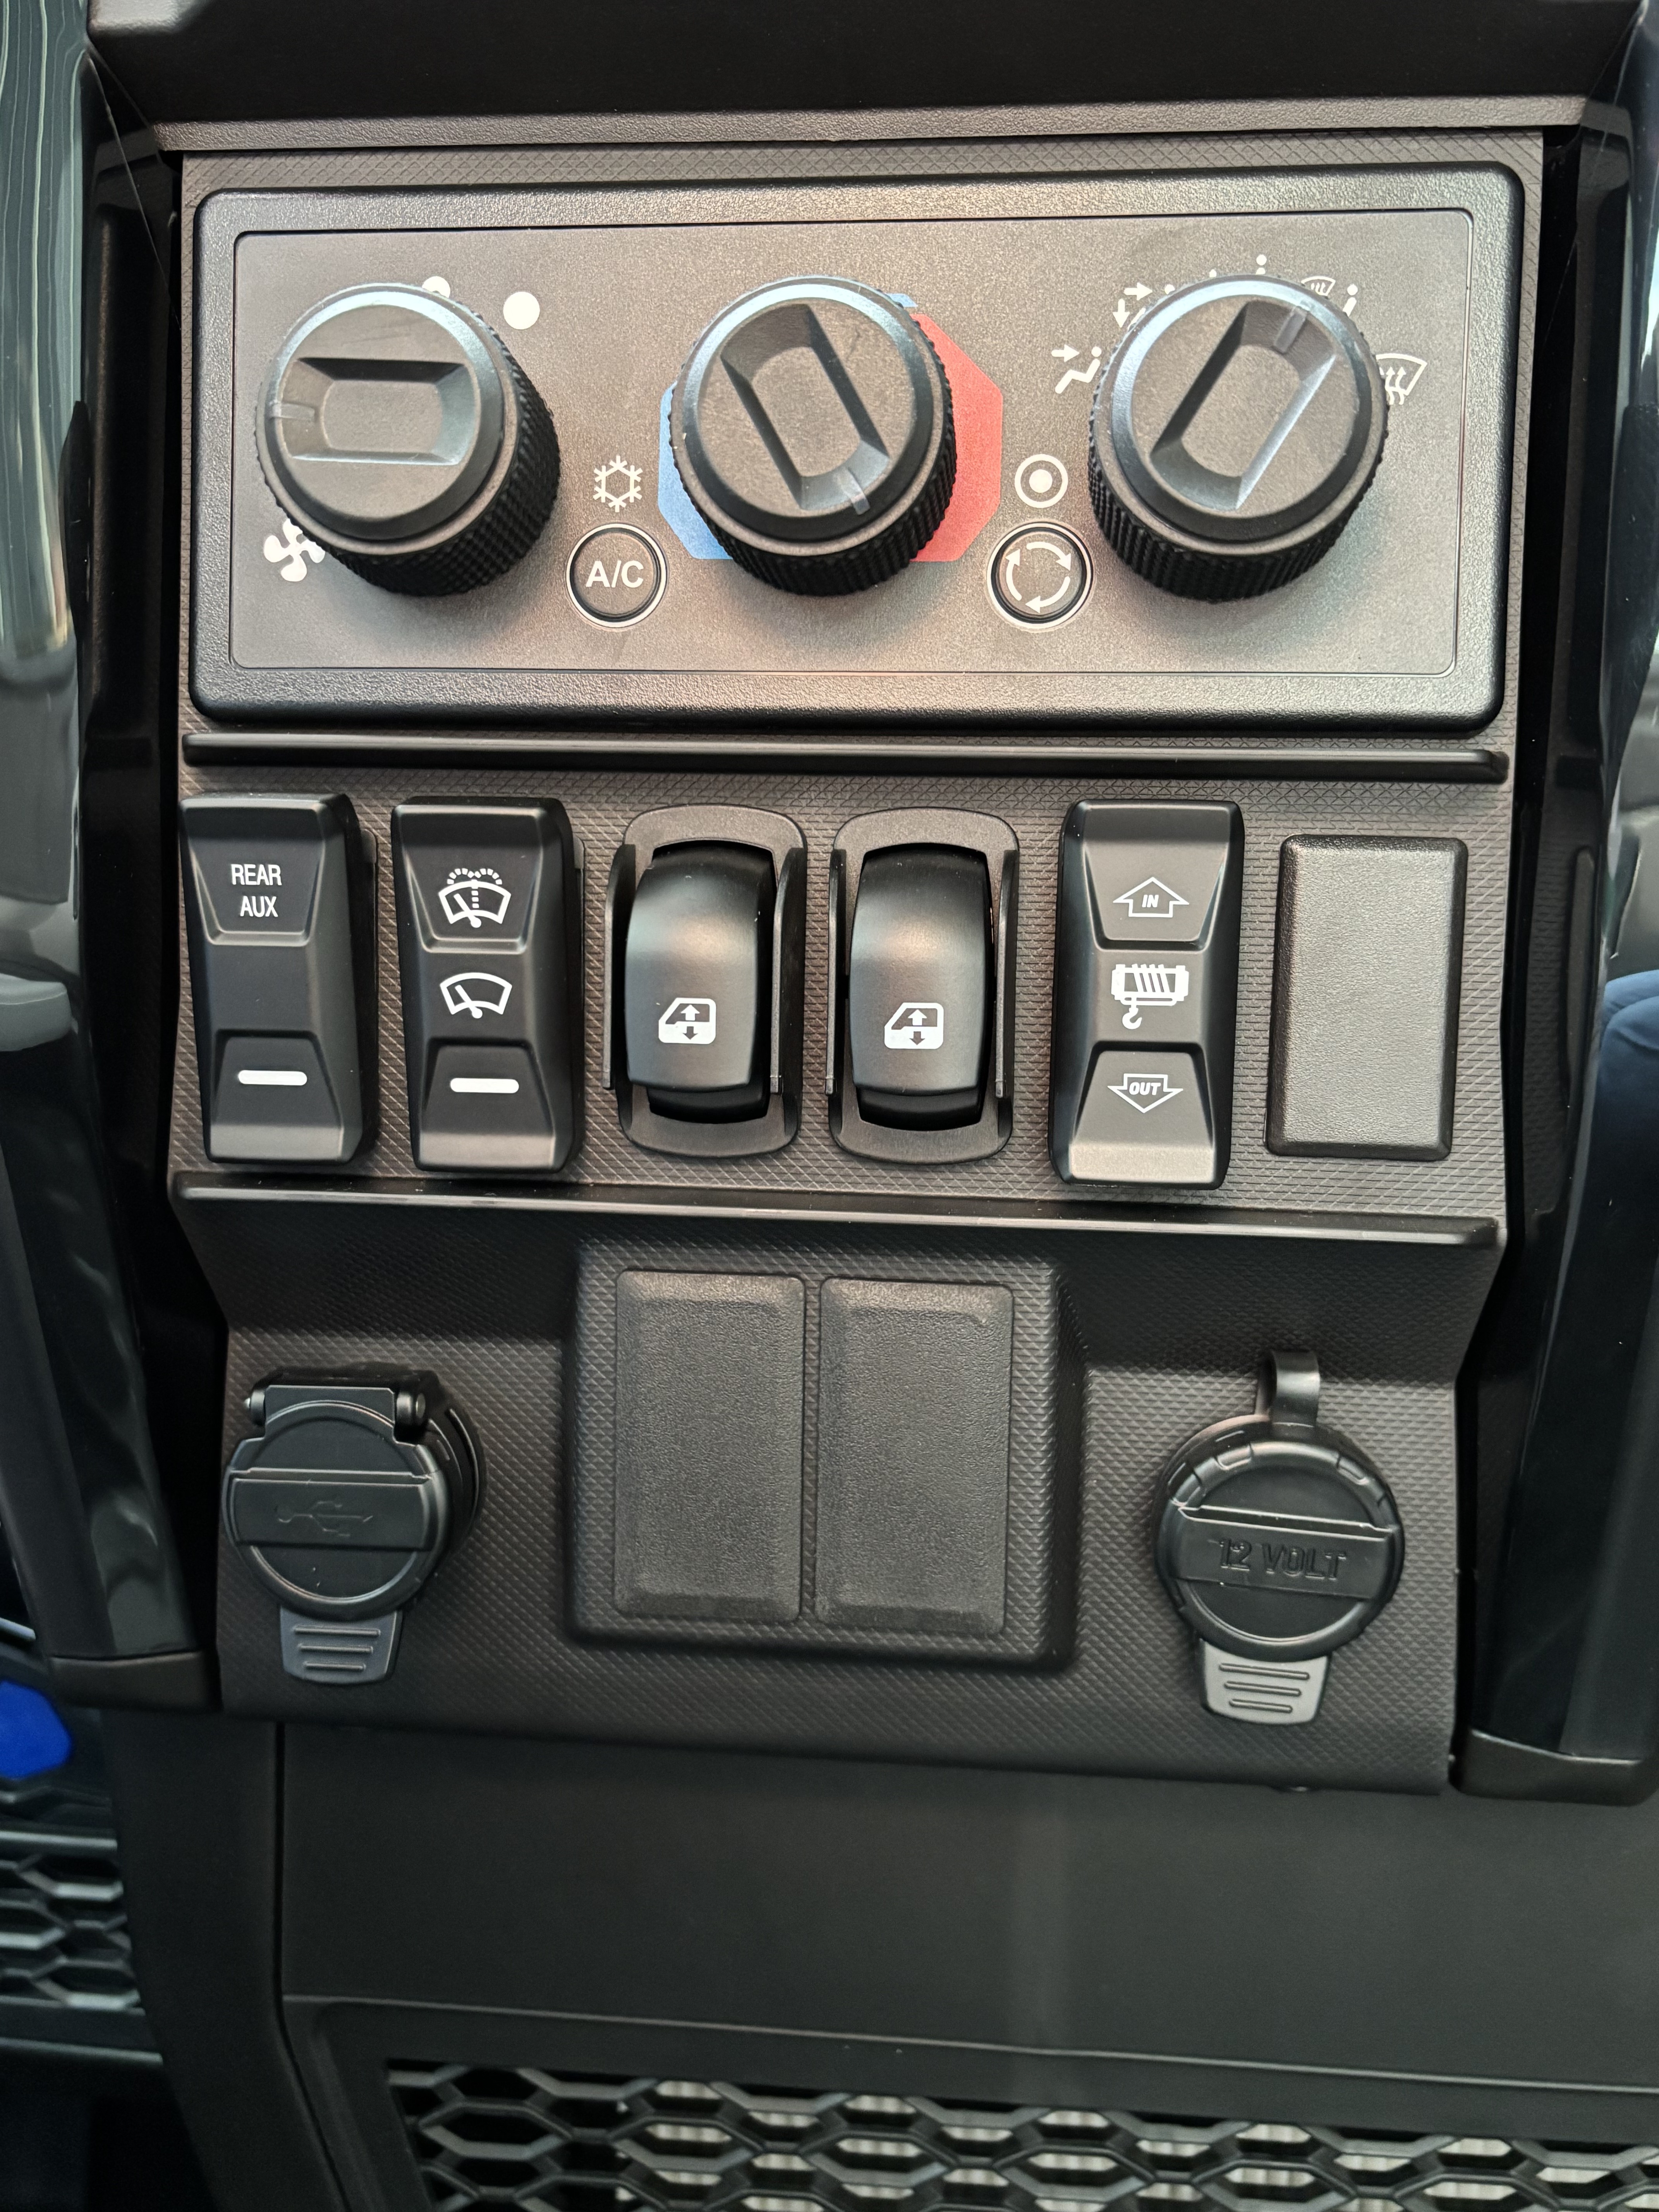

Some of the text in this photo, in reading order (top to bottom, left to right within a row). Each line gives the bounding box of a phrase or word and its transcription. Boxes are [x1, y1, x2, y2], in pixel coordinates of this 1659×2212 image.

[585, 560, 644, 588] A/C
[232, 864, 282, 886] REAR
[240, 896, 278, 917] AUX
[1142, 894, 1159, 908] IN
[1129, 1081, 1161, 1096] OUT
[1217, 1538, 1347, 1581] 12 VOLT
